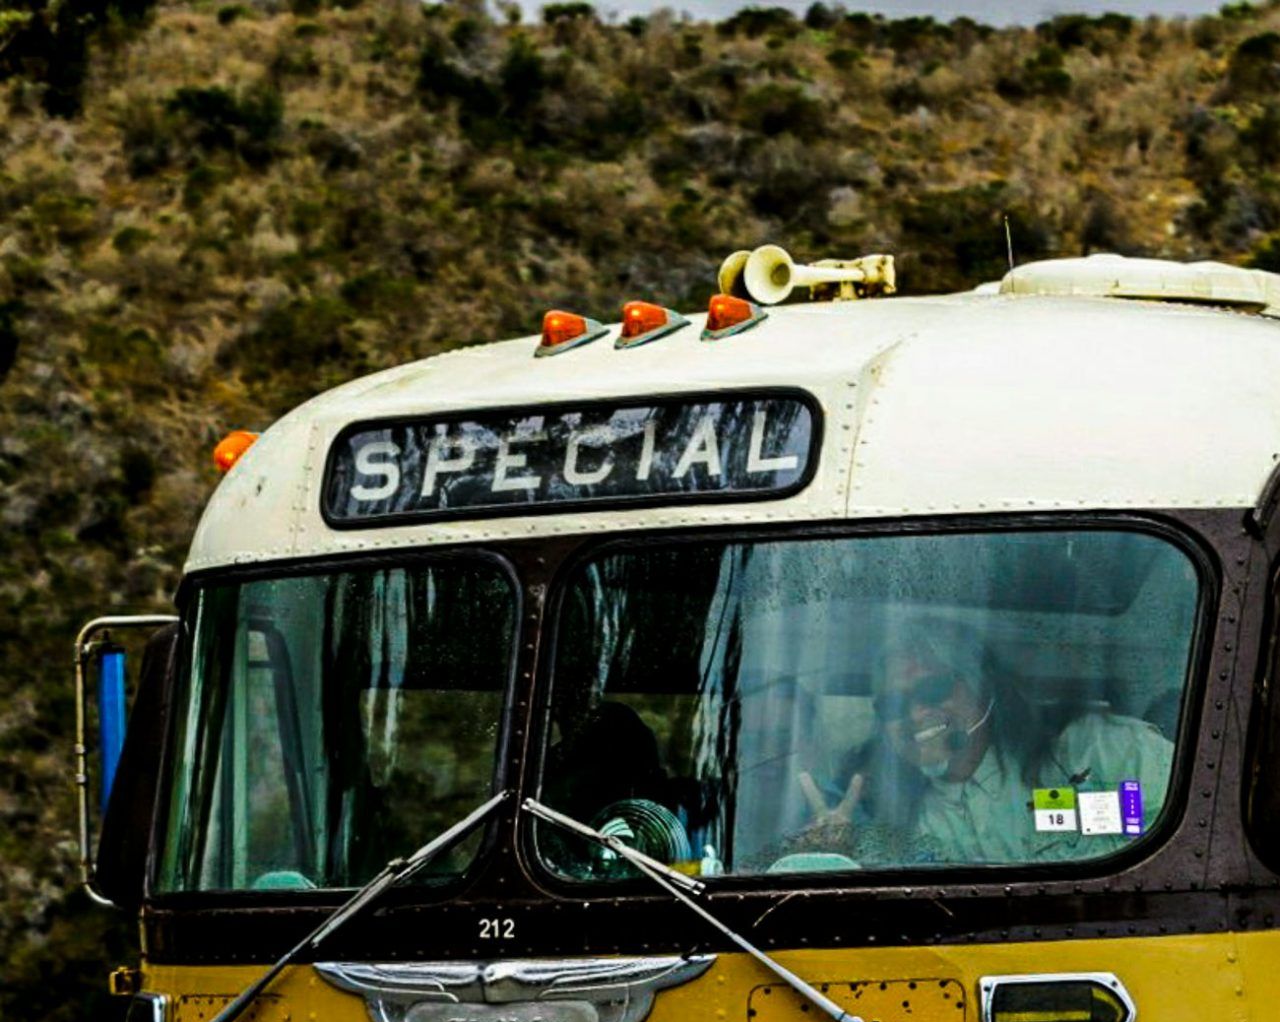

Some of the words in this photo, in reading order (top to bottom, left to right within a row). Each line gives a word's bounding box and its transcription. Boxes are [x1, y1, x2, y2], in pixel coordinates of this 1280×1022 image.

[350, 410, 799, 501] SPECIAL
[1048, 813, 1065, 826] 18
[478, 918, 516, 939] 212
